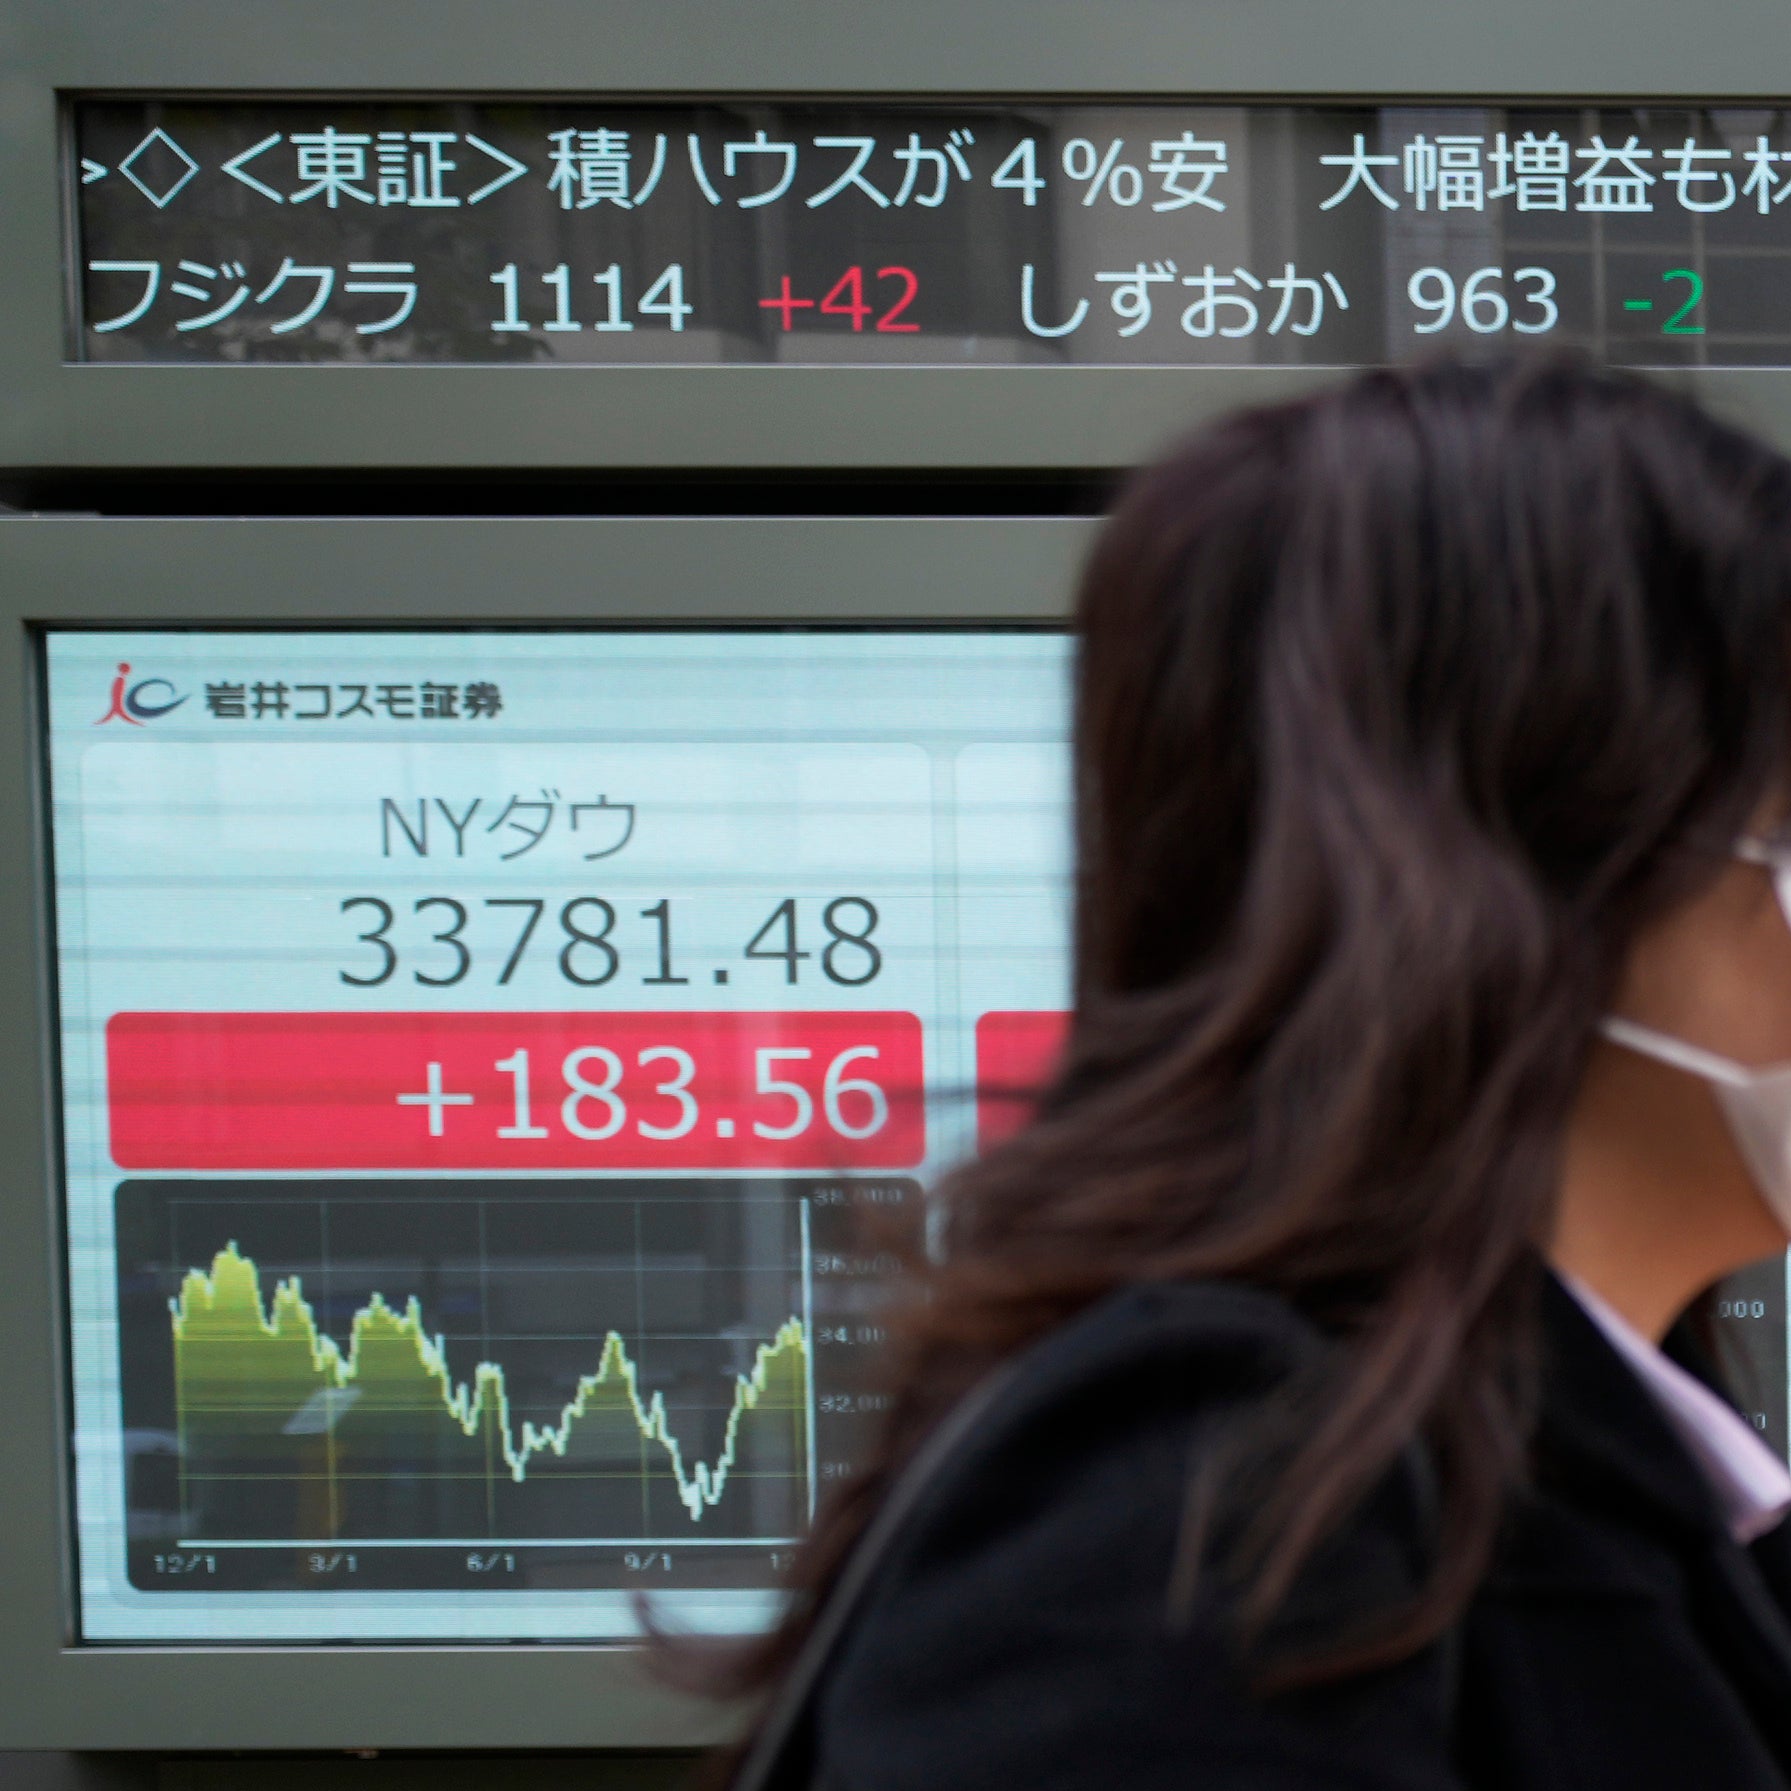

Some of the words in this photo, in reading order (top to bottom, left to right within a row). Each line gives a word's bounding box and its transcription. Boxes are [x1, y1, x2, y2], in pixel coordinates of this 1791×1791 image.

[90, 259, 414, 333] フジクラ
[491, 266, 690, 331] 1114
[760, 266, 920, 332] +42
[1022, 260, 1347, 337] しずおか
[1408, 268, 1557, 333] 963
[1625, 269, 1704, 334] -2
[206, 682, 502, 718] 岩井コスモ証券
[380, 787, 637, 862] NYダウ
[341, 897, 881, 987] 33781.48
[398, 1047, 886, 1139] +183.56
[154, 1554, 216, 1573] 12/1
[309, 1553, 358, 1573] 3/1
[466, 1553, 515, 1572] 6/1
[624, 1553, 672, 1572] 9/1
